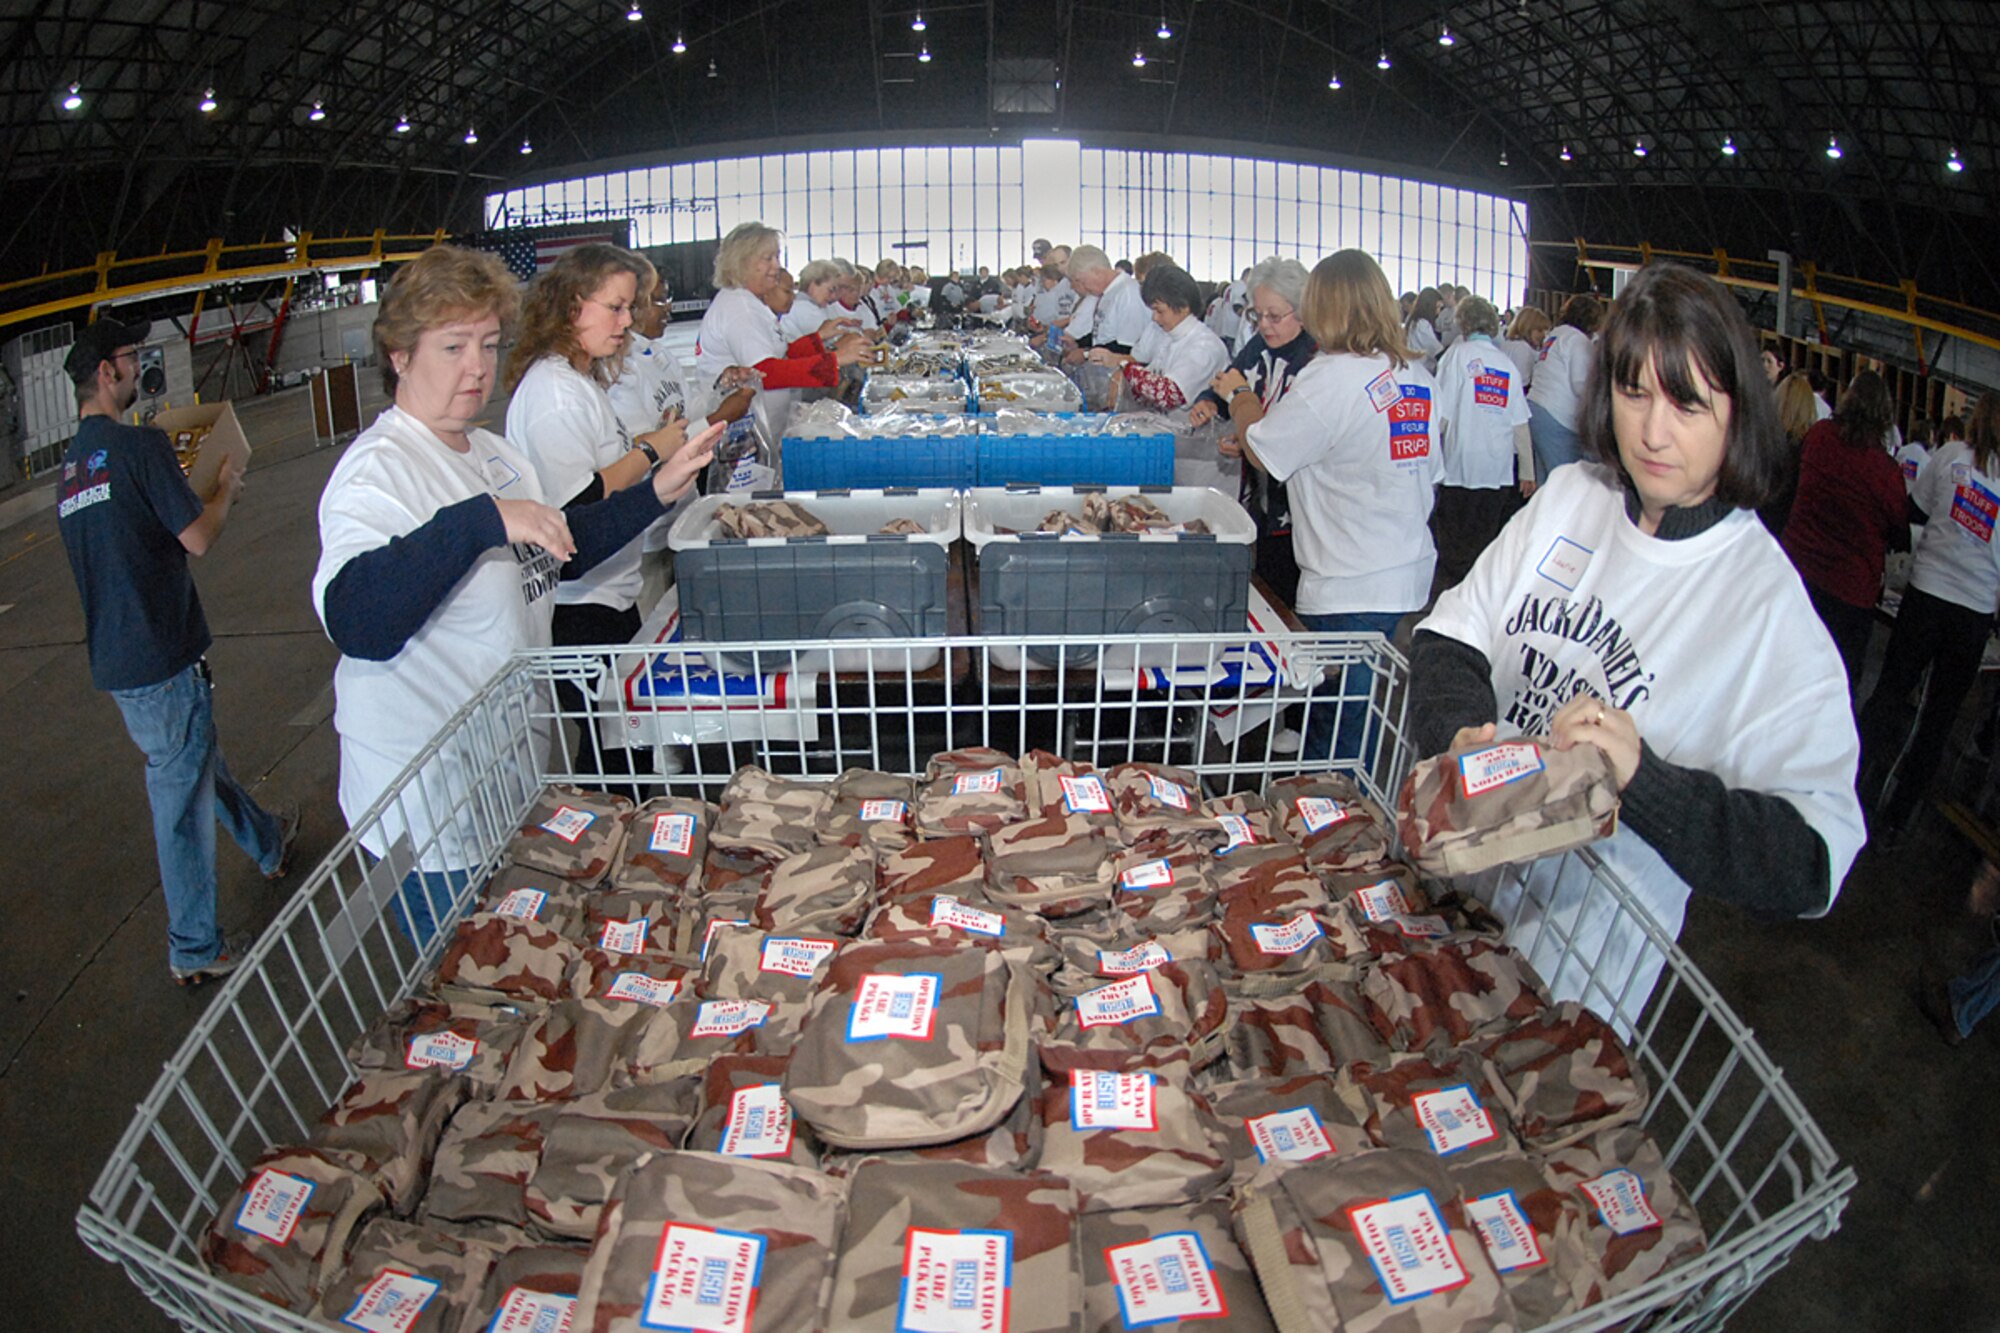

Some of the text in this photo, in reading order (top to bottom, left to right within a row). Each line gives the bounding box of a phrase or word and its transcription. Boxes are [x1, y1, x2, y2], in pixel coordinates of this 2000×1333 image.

[1505, 593, 1655, 711] JACK DANIEL'S
[1135, 1074, 1145, 1118] PACKA
[727, 1094, 747, 1153] OPERATION
[743, 1105, 766, 1140] USO
[765, 1110, 776, 1136] CARE
[247, 1177, 272, 1216] PACKAGE
[259, 1188, 276, 1210] CARE
[276, 1185, 307, 1236] OPERATION
[1606, 1187, 1620, 1214] CARE
[1384, 1225, 1422, 1269] USO
[1411, 1228, 1434, 1261] CARE
[1418, 1211, 1453, 1269] PACKAGE
[1498, 1198, 1533, 1258] OPERATION
[660, 1240, 685, 1306] PACKAGE
[1154, 1254, 1191, 1294] USO
[1179, 1238, 1211, 1306] OPERATION
[1363, 1214, 1406, 1293] OPERATION
[680, 1257, 699, 1295] CARE
[695, 1256, 730, 1307] USO
[723, 1243, 751, 1326] OPERATION
[913, 1246, 931, 1310] PACKAGE
[933, 1262, 947, 1299] CARE
[949, 1259, 980, 1310] USO
[981, 1239, 997, 1330] OPERATION
[1121, 1258, 1145, 1305] PACKAGE
[1140, 1264, 1158, 1290] CARE
[351, 1278, 395, 1320] OPERATION
[389, 1299, 411, 1318] CARE
[394, 1293, 426, 1329] PACKAGE
[502, 1292, 527, 1331] PACKAGE
[519, 1302, 536, 1326] CARE
